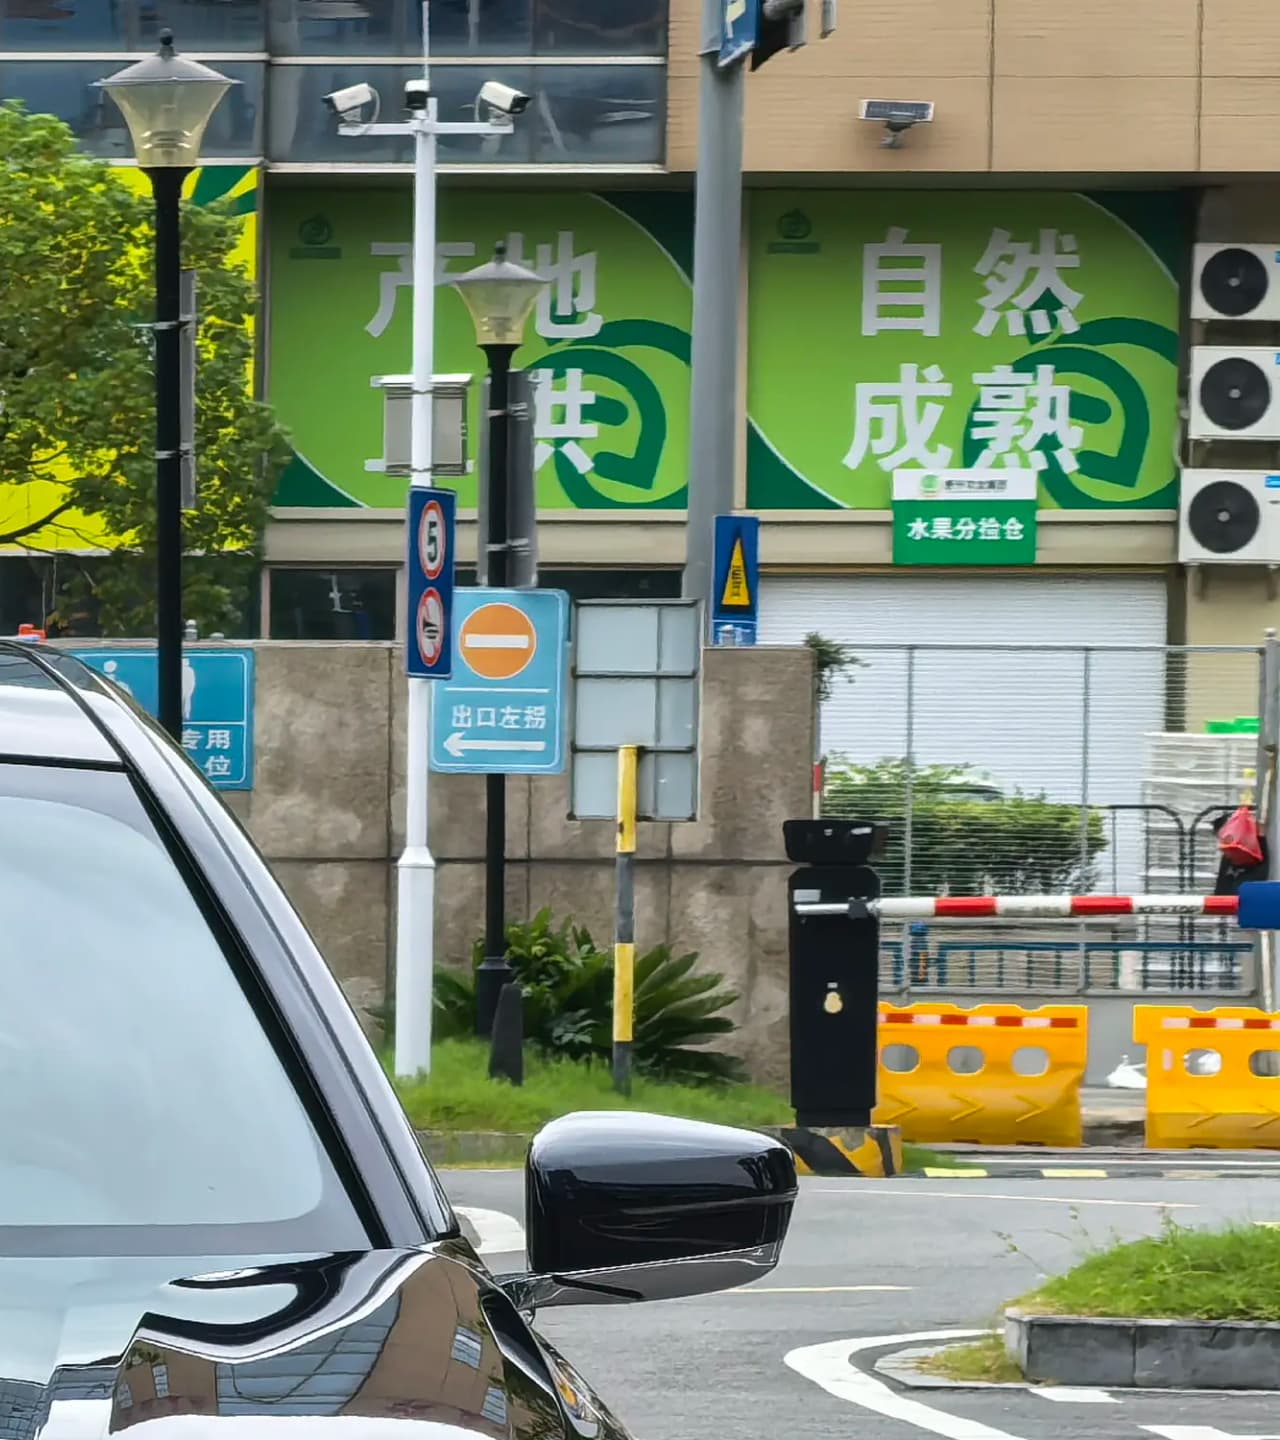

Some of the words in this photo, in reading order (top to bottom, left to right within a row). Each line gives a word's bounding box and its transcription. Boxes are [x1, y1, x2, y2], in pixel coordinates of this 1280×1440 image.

[860, 226, 1085, 337] 自然
[841, 362, 1085, 475] 成熟
[426, 520, 439, 563] 5
[451, 704, 547, 730] 出口左拐
[204, 755, 232, 777] 位
